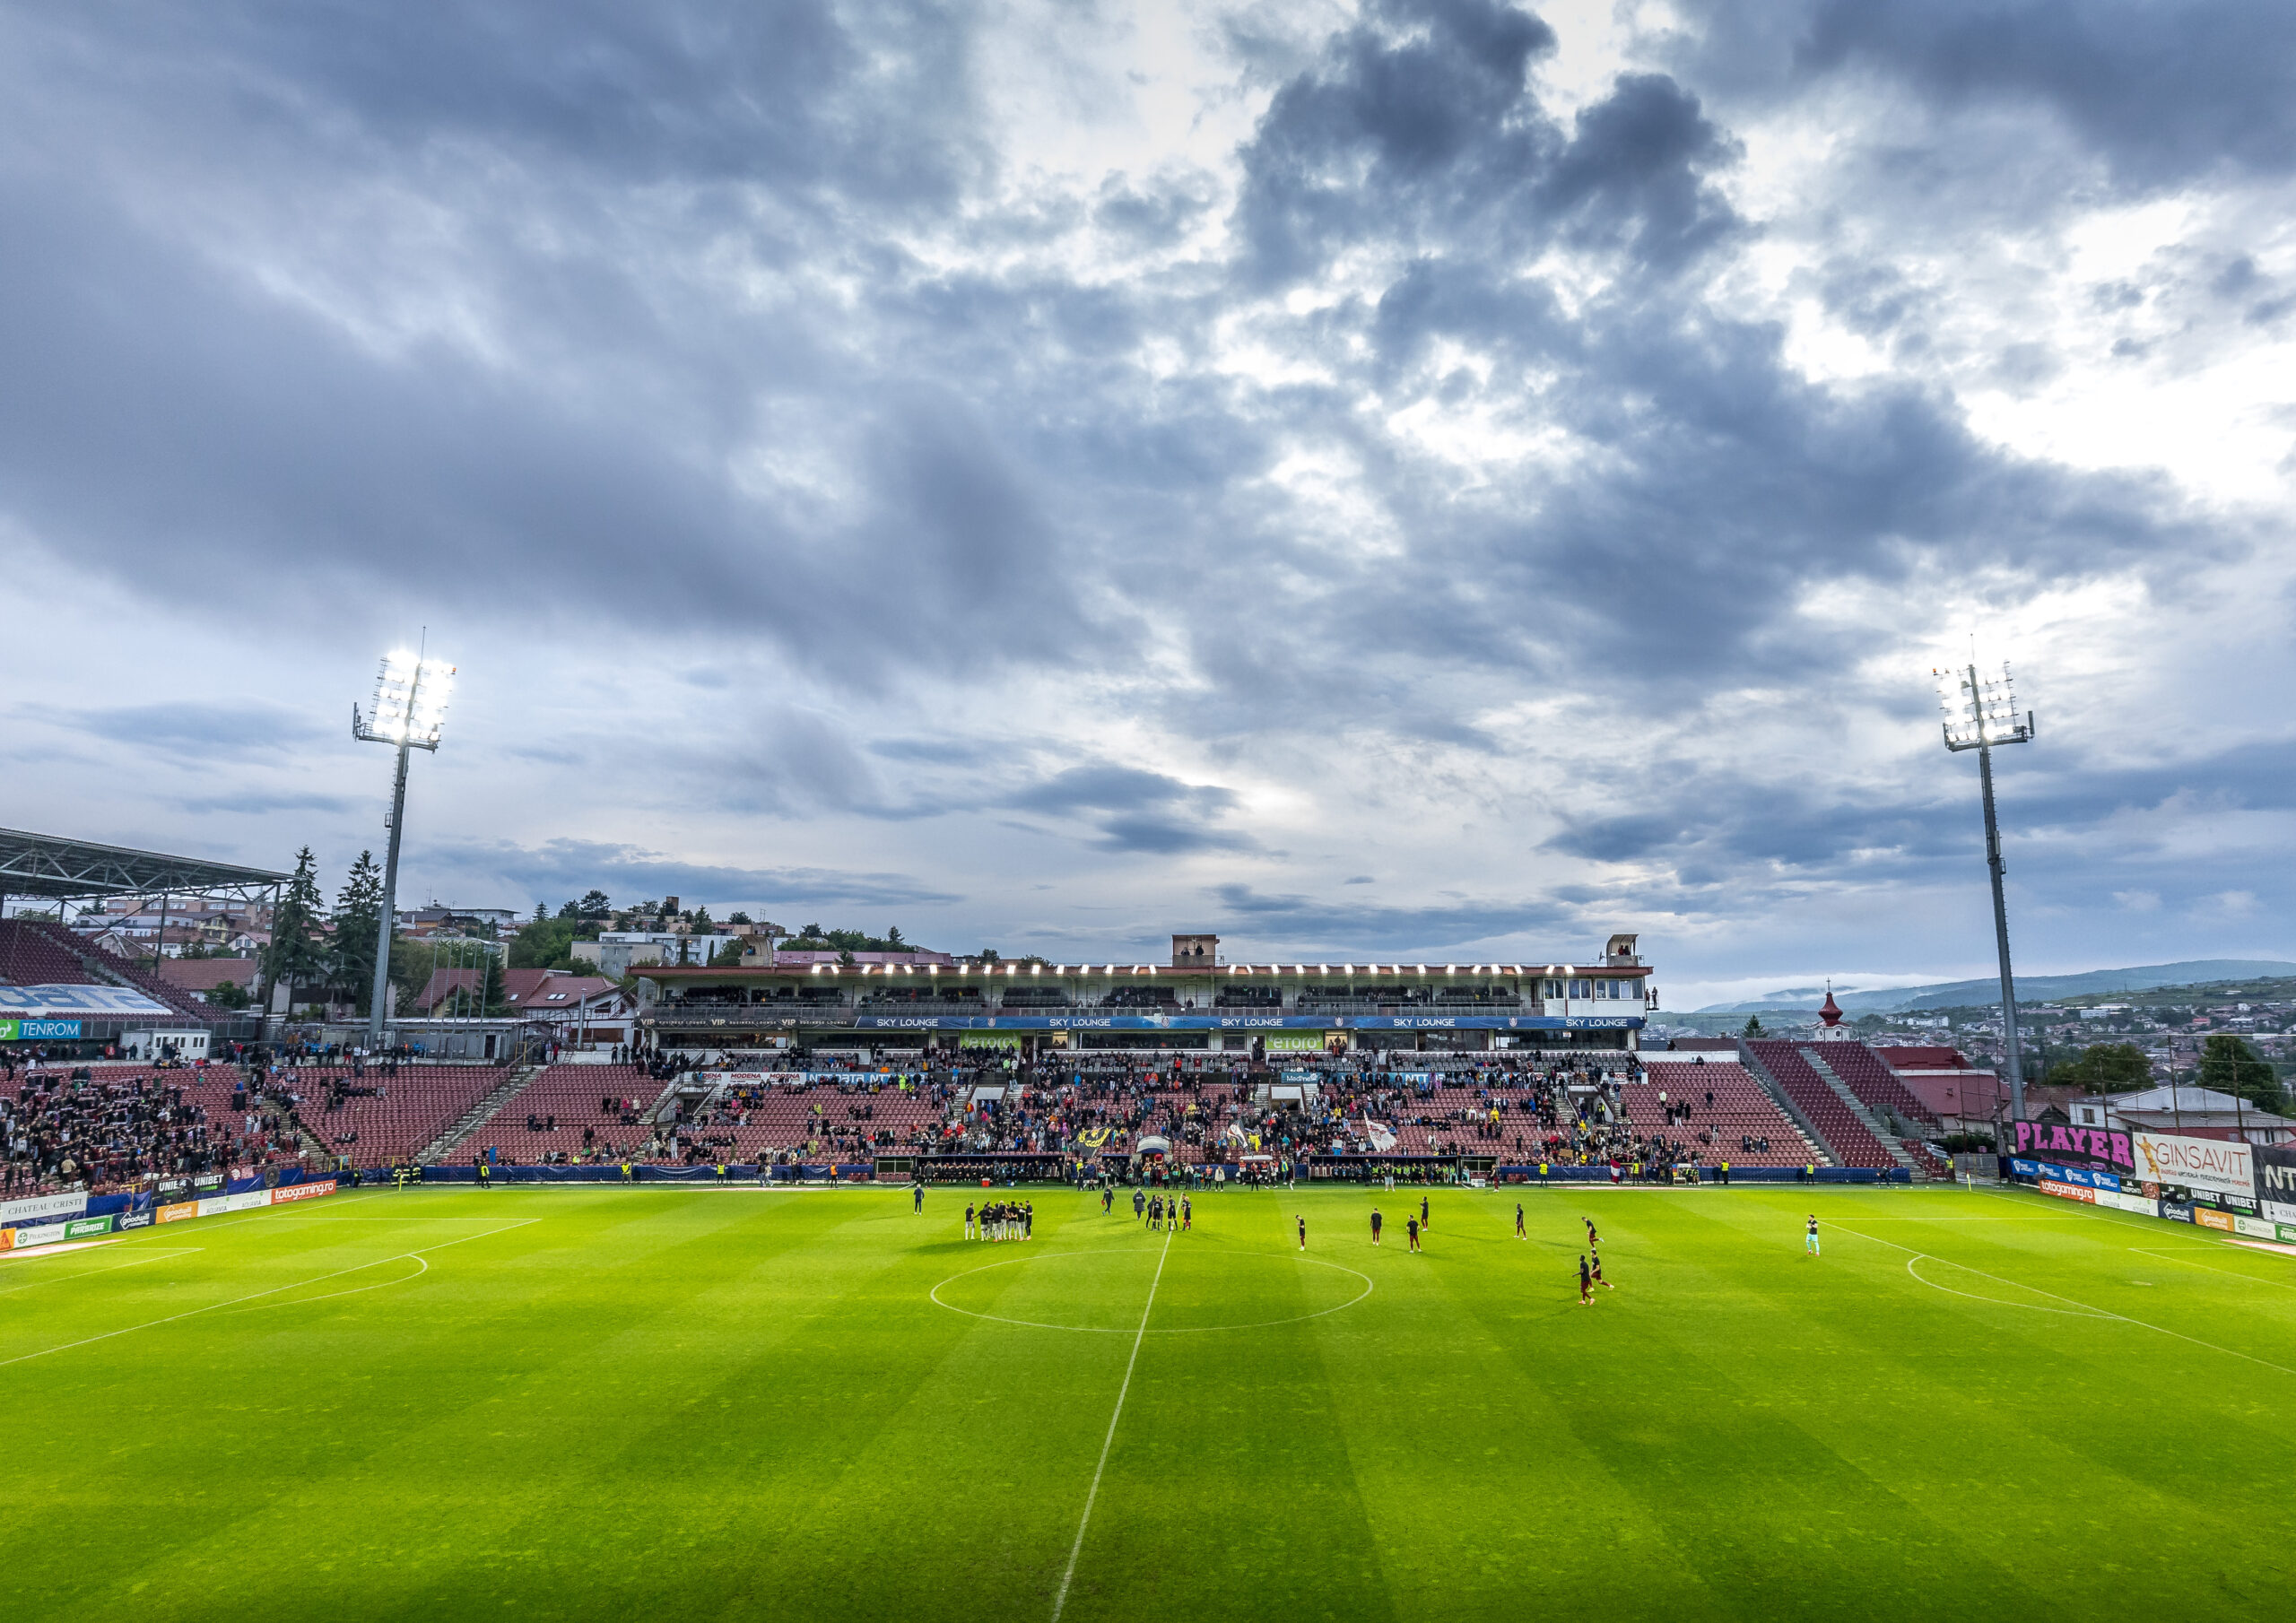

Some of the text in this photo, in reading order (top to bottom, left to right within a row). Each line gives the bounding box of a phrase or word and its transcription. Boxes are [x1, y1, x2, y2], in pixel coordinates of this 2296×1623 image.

[22, 1022, 78, 1037] TENROM
[876, 1019, 938, 1027] SKY LOUNGE
[1049, 1019, 1111, 1027] SKY LOUNGE
[1221, 1019, 1283, 1027] SKY LOUNGE
[1393, 1019, 1456, 1027] SKY LOUNGE
[1566, 1019, 1628, 1027] SKY LOUNGE
[2015, 1122, 2134, 1168] PLAYER
[2156, 1142, 2246, 1176] GINSAVIT
[194, 1174, 224, 1187] UNIBET
[275, 1182, 334, 1201] totogaming.ro
[2041, 1181, 2093, 1200] totogaming.ro
[2190, 1188, 2221, 1203] UNIBET
[8, 1198, 83, 1215] CHATEAU CRISTI
[2224, 1194, 2257, 1210] UNIBET
[122, 1213, 150, 1226] goodwill
[2166, 1208, 2189, 1217] goodwill
